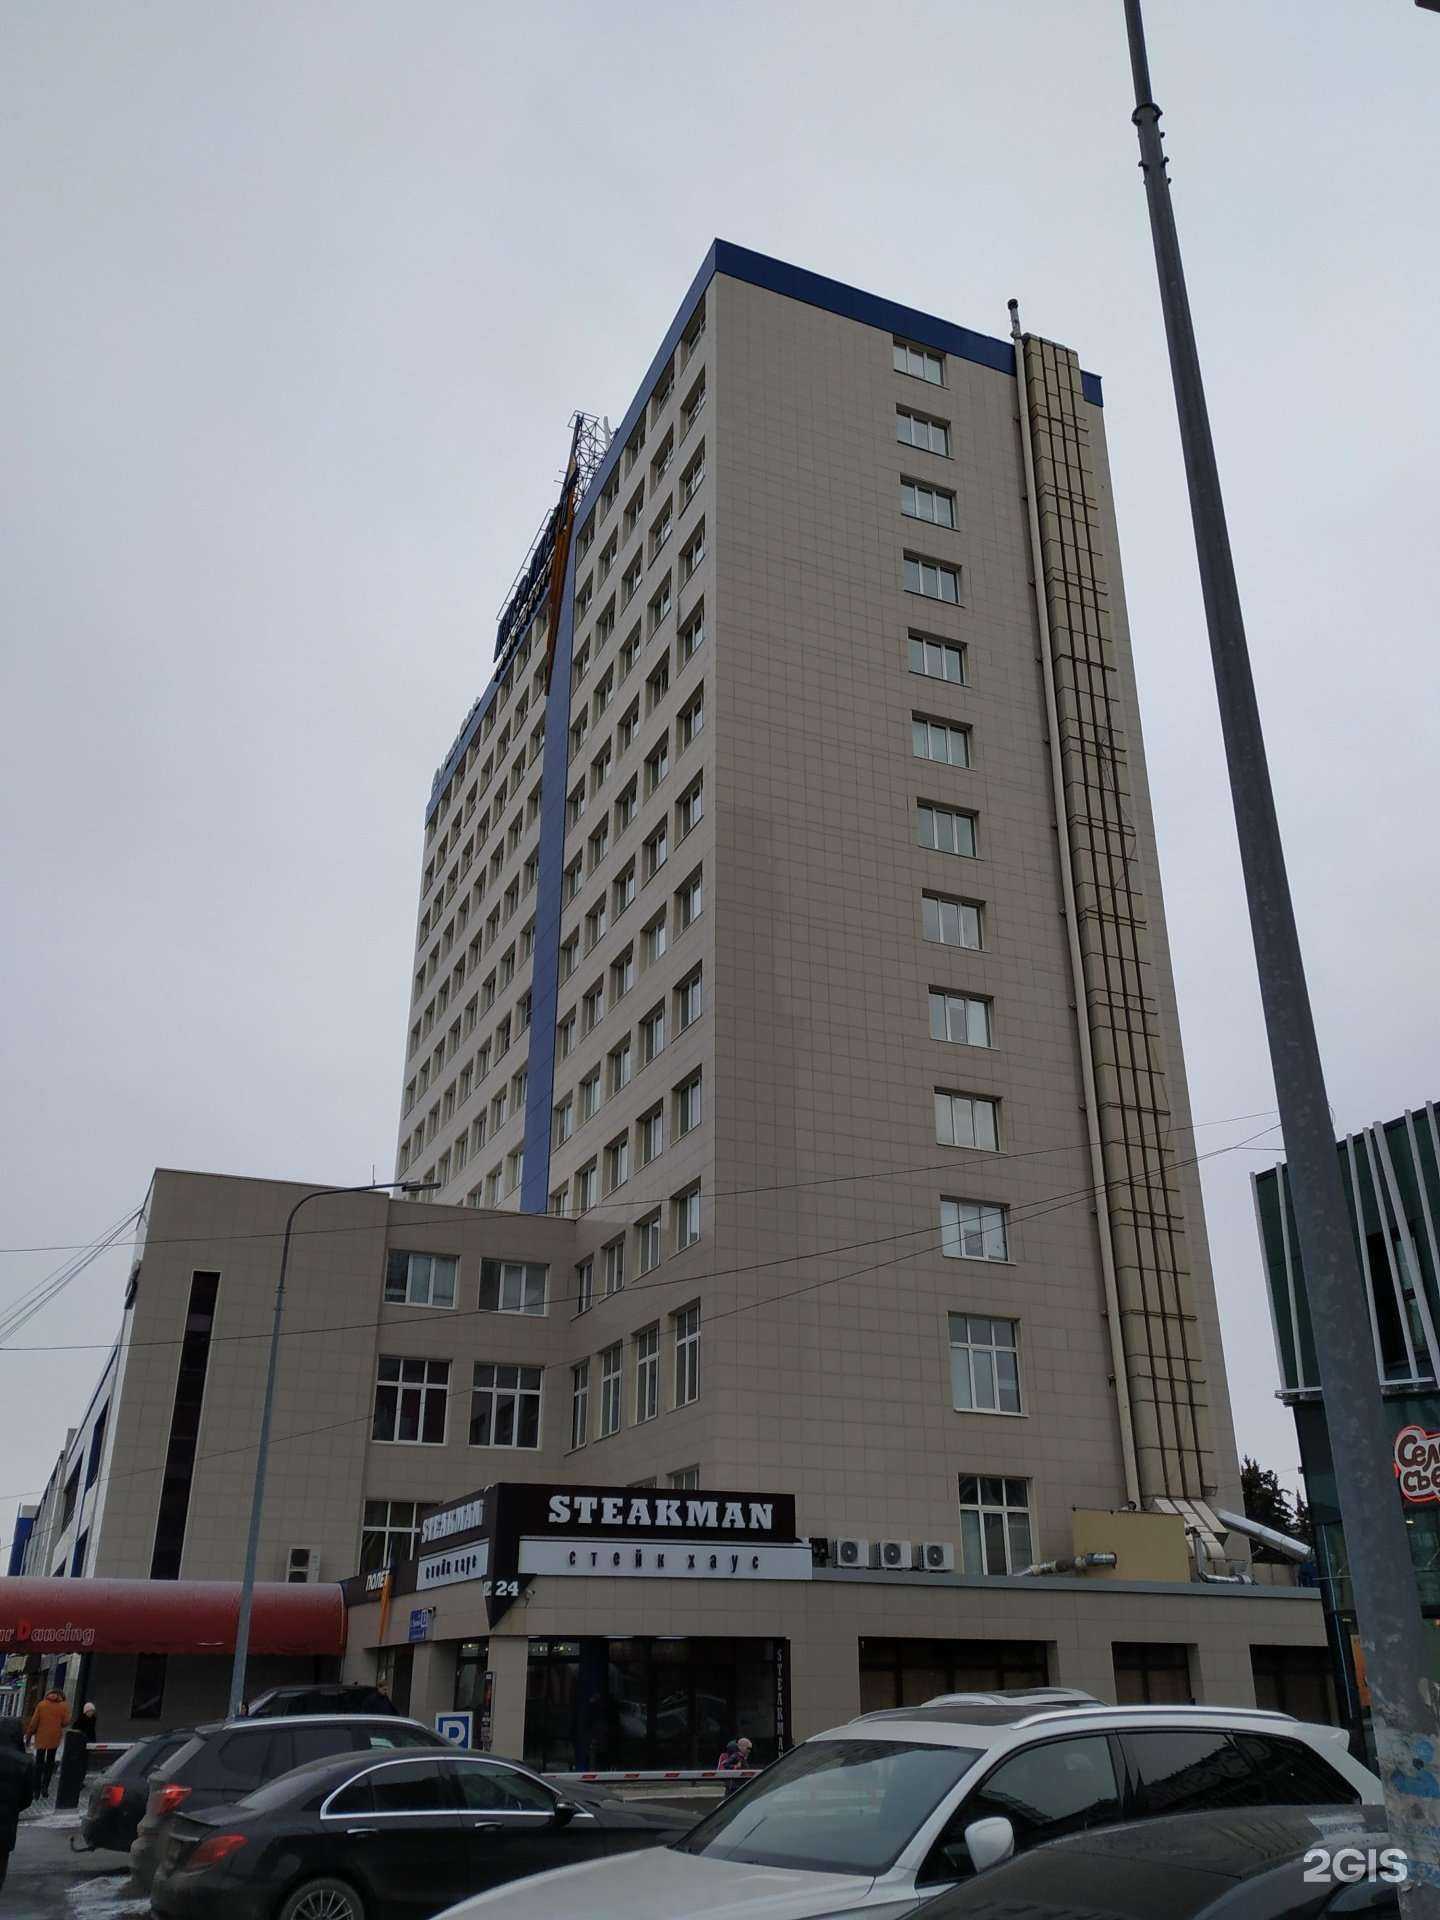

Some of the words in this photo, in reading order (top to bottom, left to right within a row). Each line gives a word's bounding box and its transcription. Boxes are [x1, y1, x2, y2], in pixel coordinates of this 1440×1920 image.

[421, 1500, 484, 1544] STEAKMAN
[548, 1495, 774, 1530] STEAKMAN
[568, 1550, 665, 1569] стейк
[687, 1552, 760, 1574] хаус
[495, 1580, 519, 1596] 24
[17, 1619, 96, 1646] Dancing
